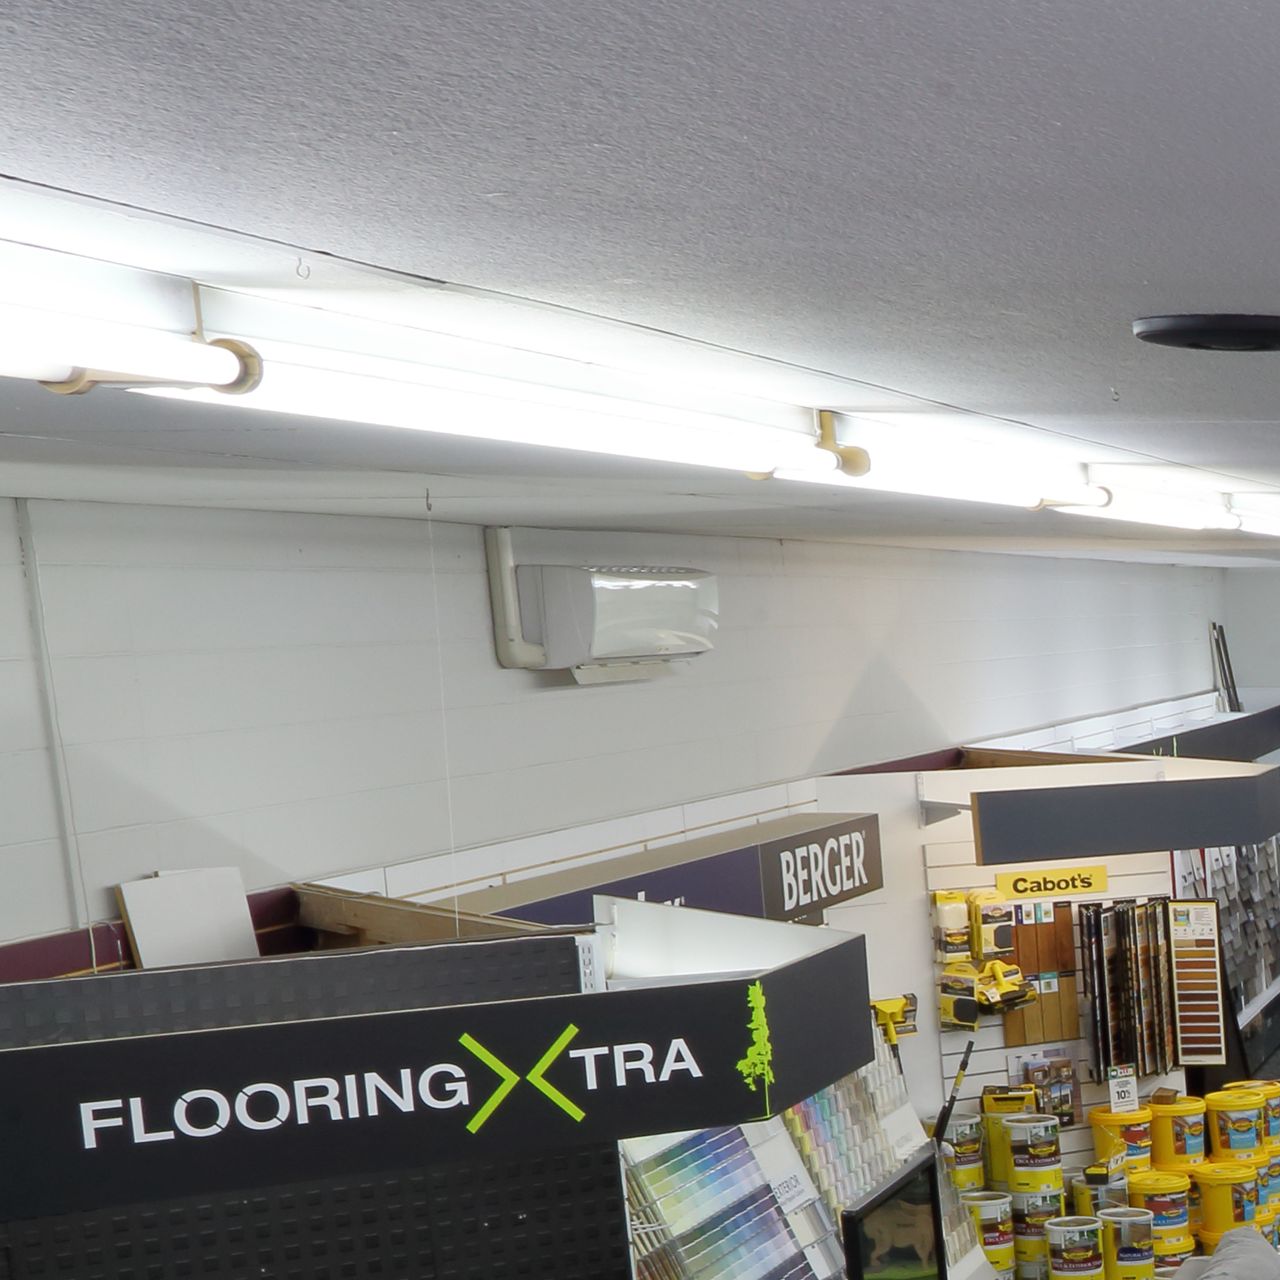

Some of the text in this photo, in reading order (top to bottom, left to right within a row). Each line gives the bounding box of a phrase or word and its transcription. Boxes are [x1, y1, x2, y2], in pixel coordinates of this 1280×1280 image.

[779, 830, 869, 911] BERGER
[1012, 873, 1093, 894] Cabot's
[79, 1023, 703, 1150] FLOORINGXTRA
